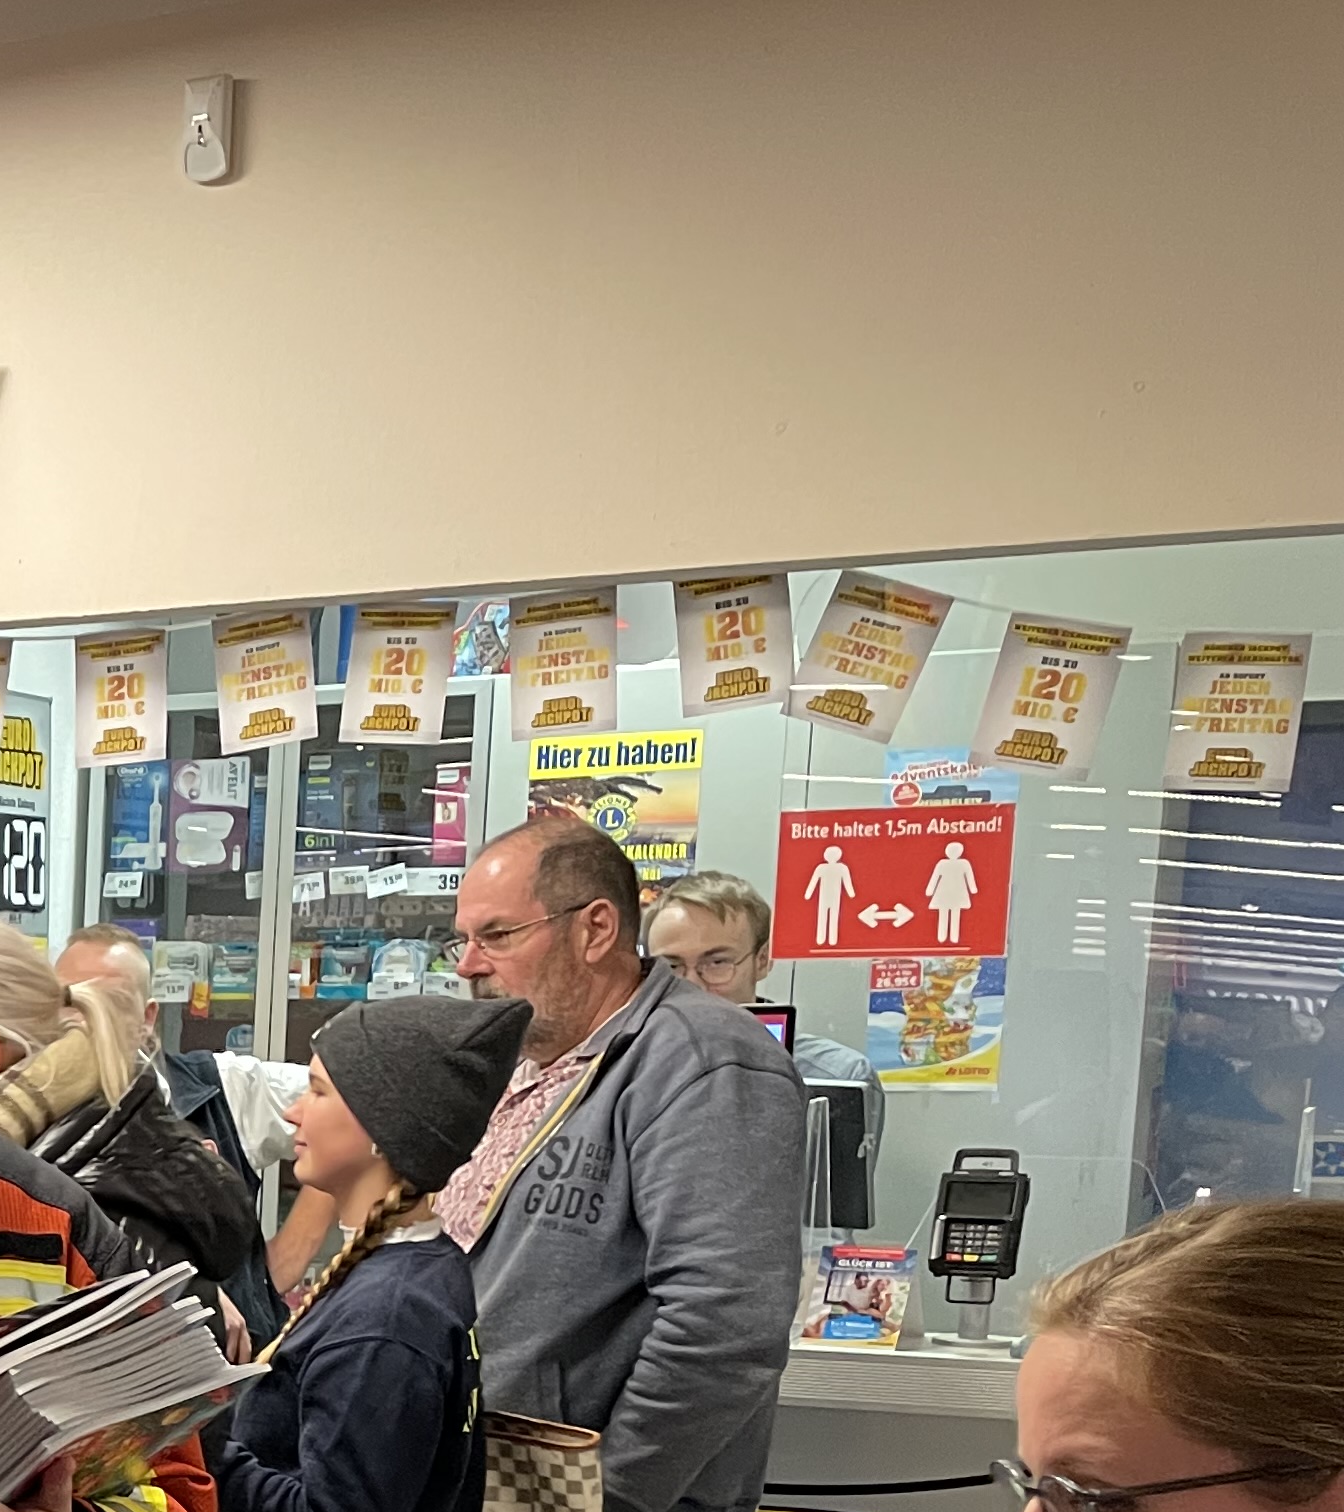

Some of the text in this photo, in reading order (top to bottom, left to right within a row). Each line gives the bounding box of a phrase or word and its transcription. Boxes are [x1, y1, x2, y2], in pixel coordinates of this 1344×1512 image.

[1018, 667, 1089, 705] 120
[537, 737, 697, 770] Hier zu haben!
[994, 740, 1069, 765] JACKPOT
[605, 810, 619, 828] L
[791, 816, 1002, 839] Bitte haltet 1,5m Abstand!
[2, 818, 46, 906] 120
[622, 843, 687, 860] KALENDER
[524, 1183, 604, 1225] GODS
